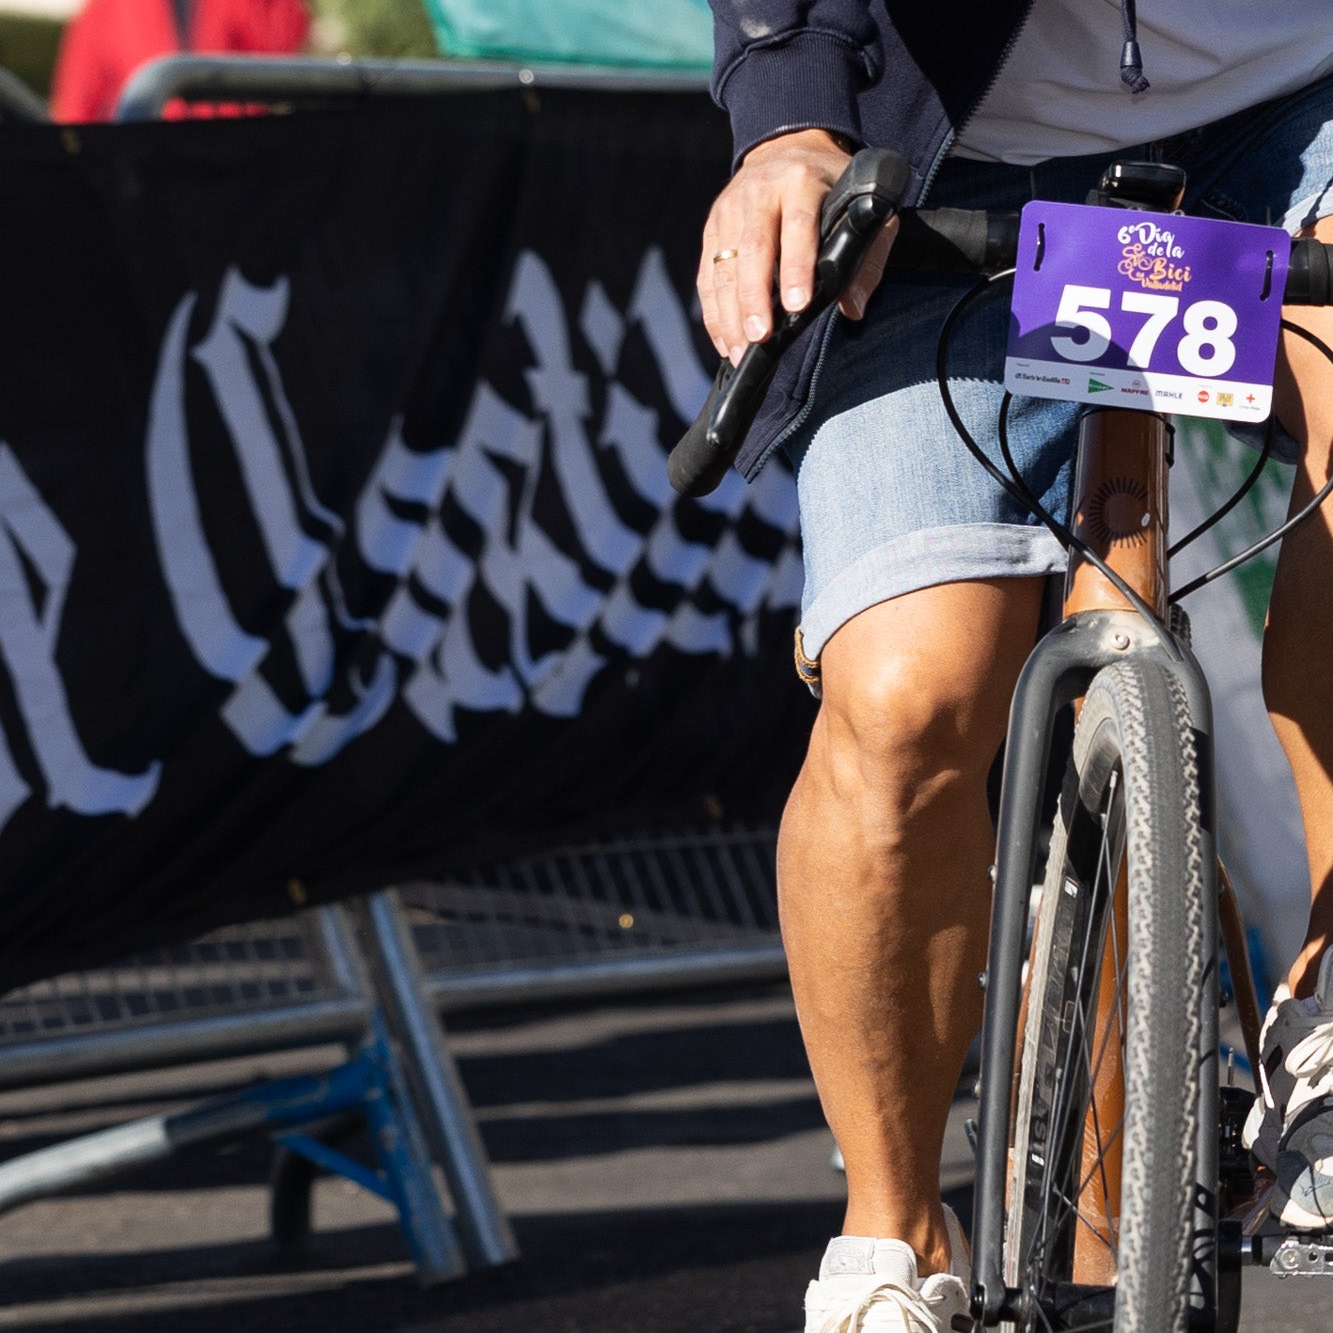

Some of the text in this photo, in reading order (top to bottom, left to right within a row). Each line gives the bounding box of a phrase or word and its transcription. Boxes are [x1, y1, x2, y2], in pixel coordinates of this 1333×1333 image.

[1147, 239, 1185, 259] de la
[1149, 257, 1192, 282] Bici
[1050, 283, 1239, 378] 578
[1155, 390, 1183, 400] MAHLE
